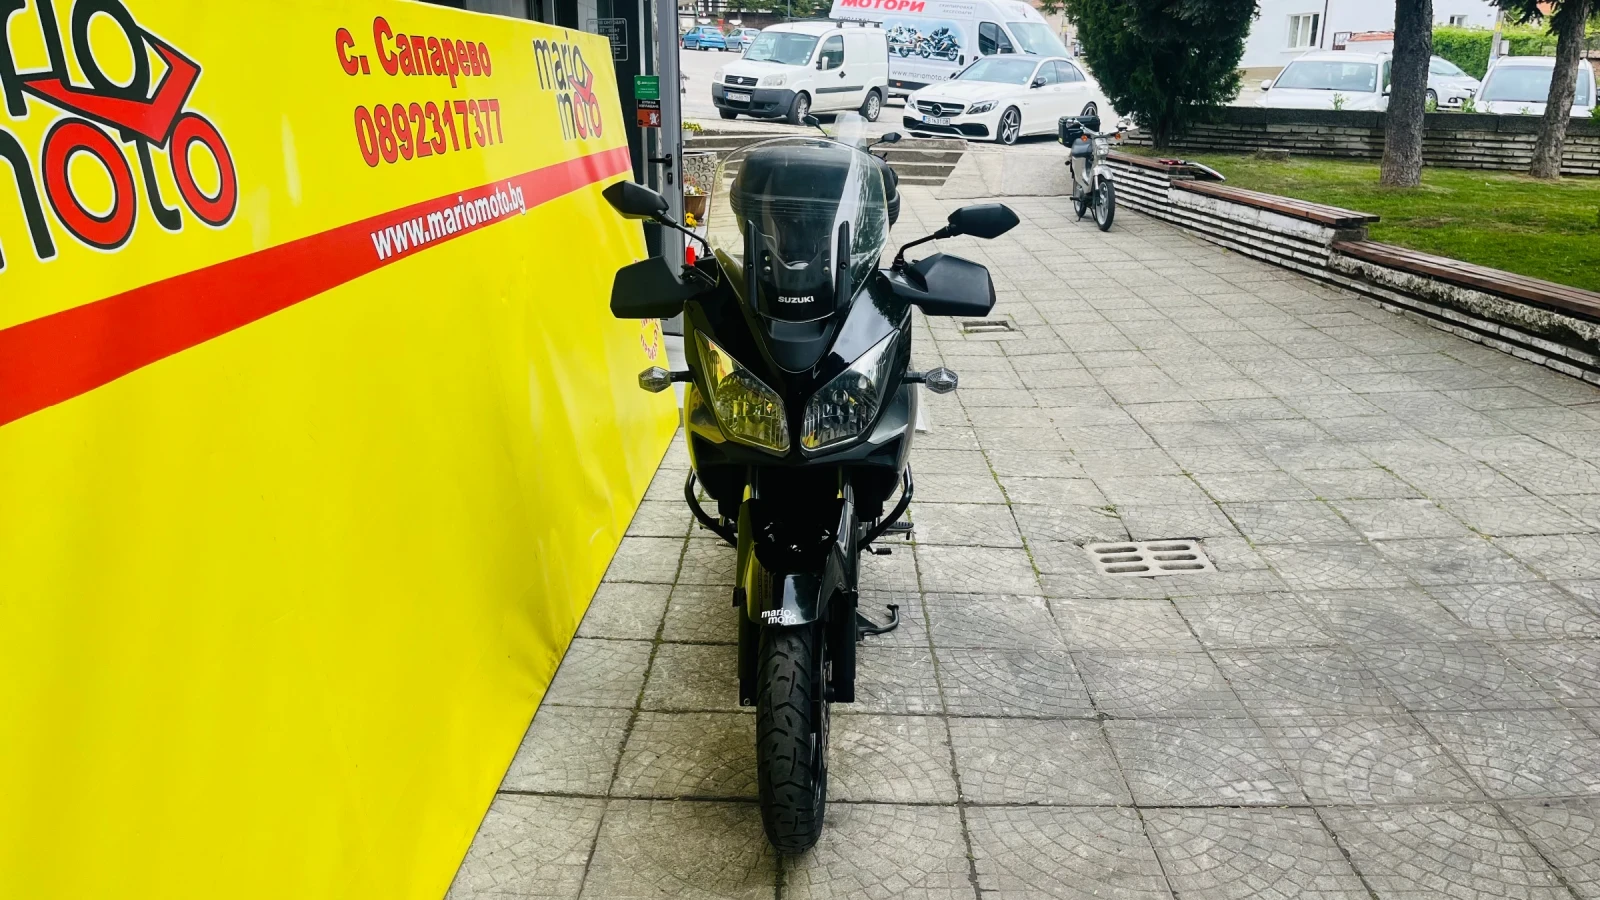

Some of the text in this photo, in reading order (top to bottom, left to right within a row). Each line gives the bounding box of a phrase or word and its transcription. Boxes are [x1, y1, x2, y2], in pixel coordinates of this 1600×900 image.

[840, 0, 925, 12] МОТОРИ
[373, 16, 492, 88] Сапарево
[532, 30, 586, 90] mario
[354, 99, 504, 168] 0892317377
[556, 92, 603, 140] moto
[370, 182, 527, 261] www.mariomoto.bg
[778, 295, 815, 304] SUZUKI
[761, 607, 792, 618] mario
[768, 615, 797, 624] moto
